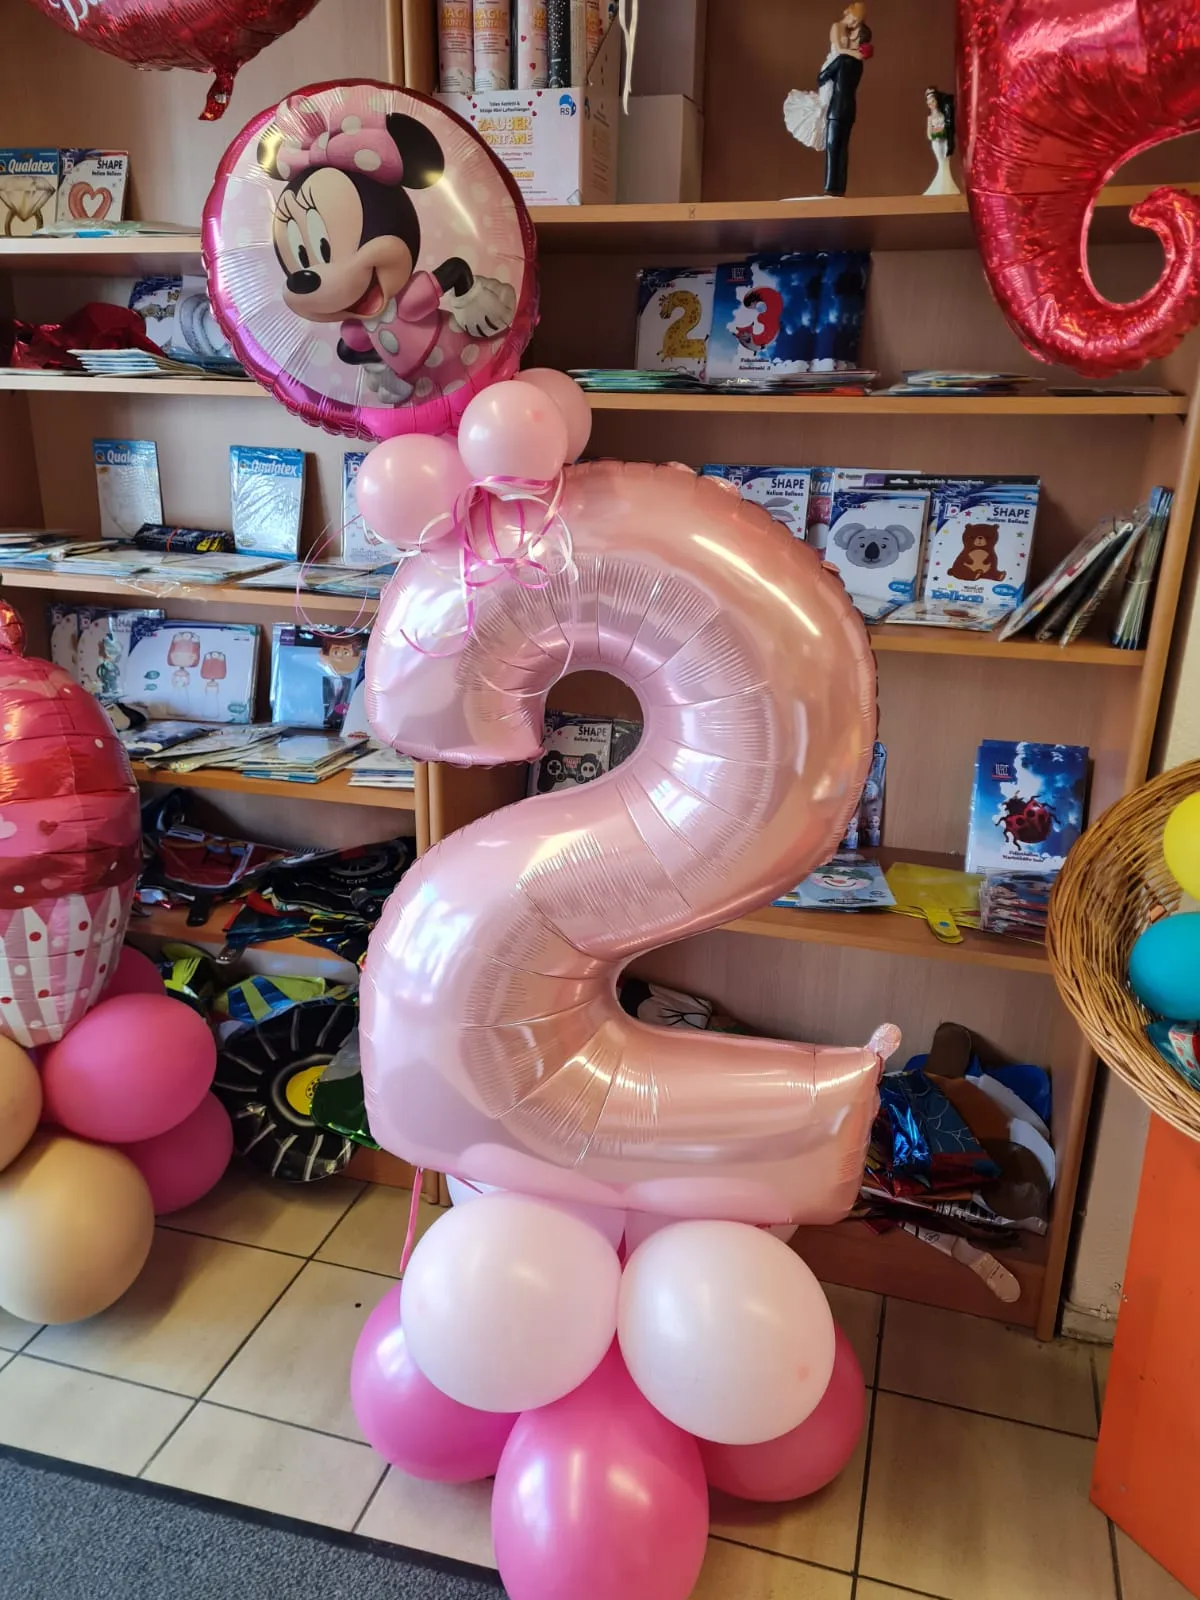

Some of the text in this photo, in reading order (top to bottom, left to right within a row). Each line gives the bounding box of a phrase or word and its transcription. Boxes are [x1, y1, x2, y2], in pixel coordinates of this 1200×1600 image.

[560, 107, 570, 116] RS
[478, 117, 533, 131] ZAUBER
[8, 159, 56, 174] Qualatex
[97, 160, 123, 170] SHAPE
[250, 460, 298, 476] Qualatex
[771, 478, 805, 489] SHAPE
[992, 507, 1031, 519] SHAPE
[578, 726, 608, 737] SHAPE
